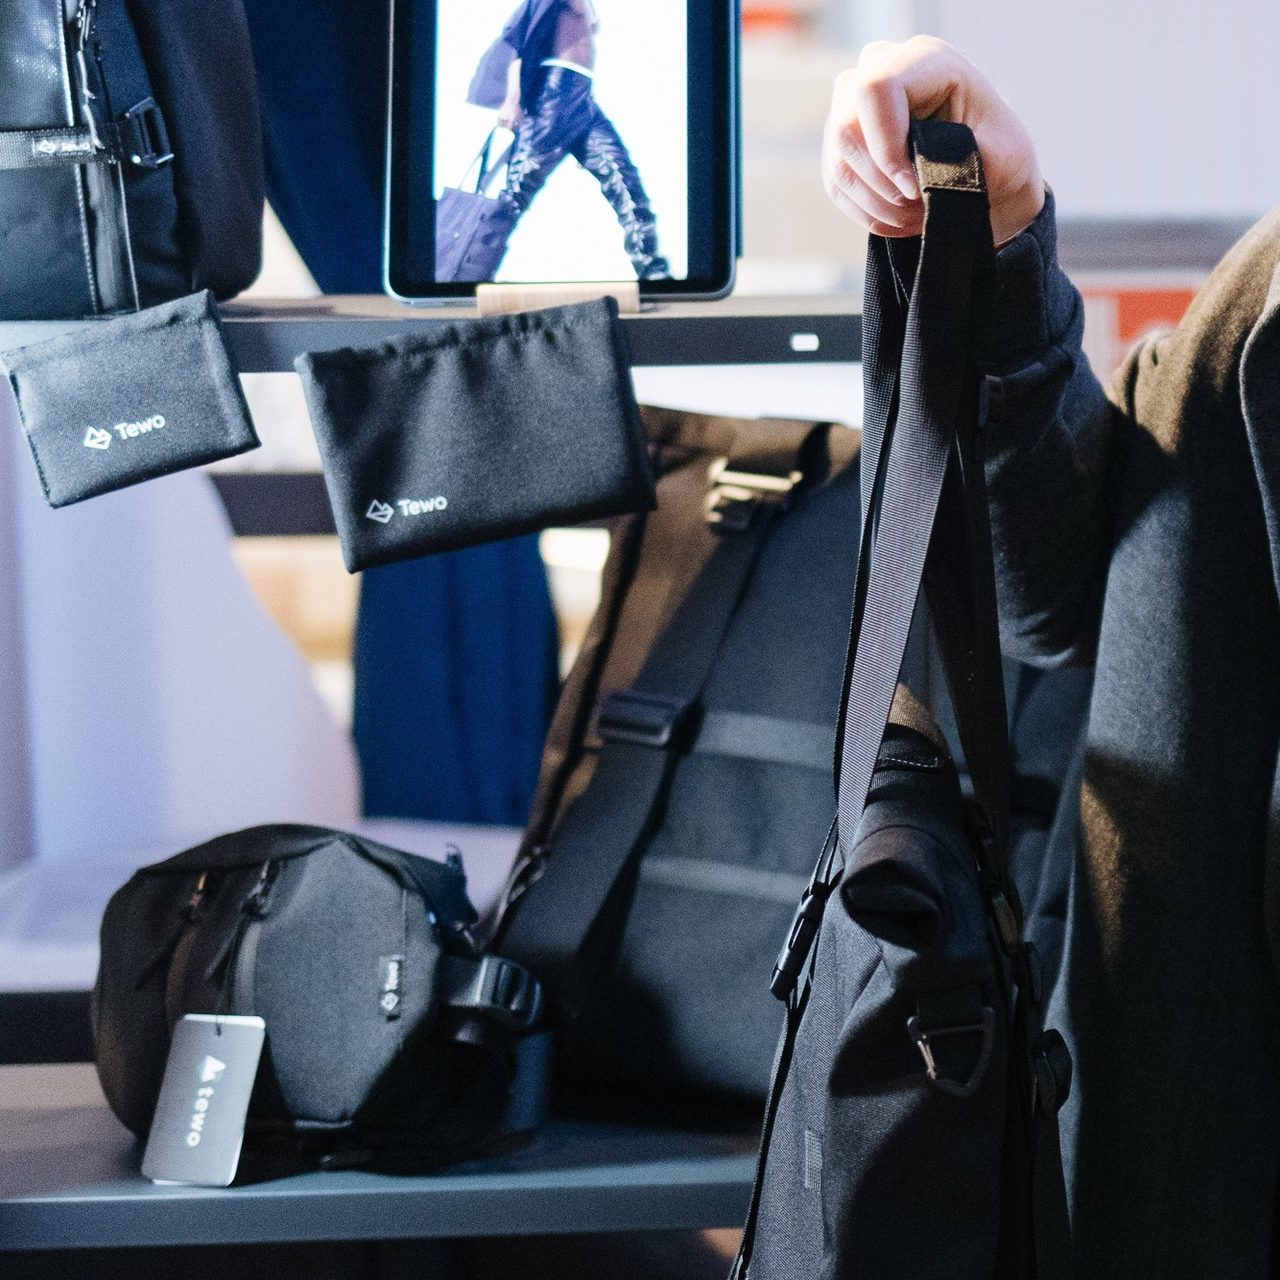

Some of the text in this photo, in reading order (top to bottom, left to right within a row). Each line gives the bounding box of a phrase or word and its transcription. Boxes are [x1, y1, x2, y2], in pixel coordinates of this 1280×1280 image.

[113, 414, 166, 440] Tewo
[397, 495, 448, 517] Tewo
[186, 1086, 214, 1147] tewo
